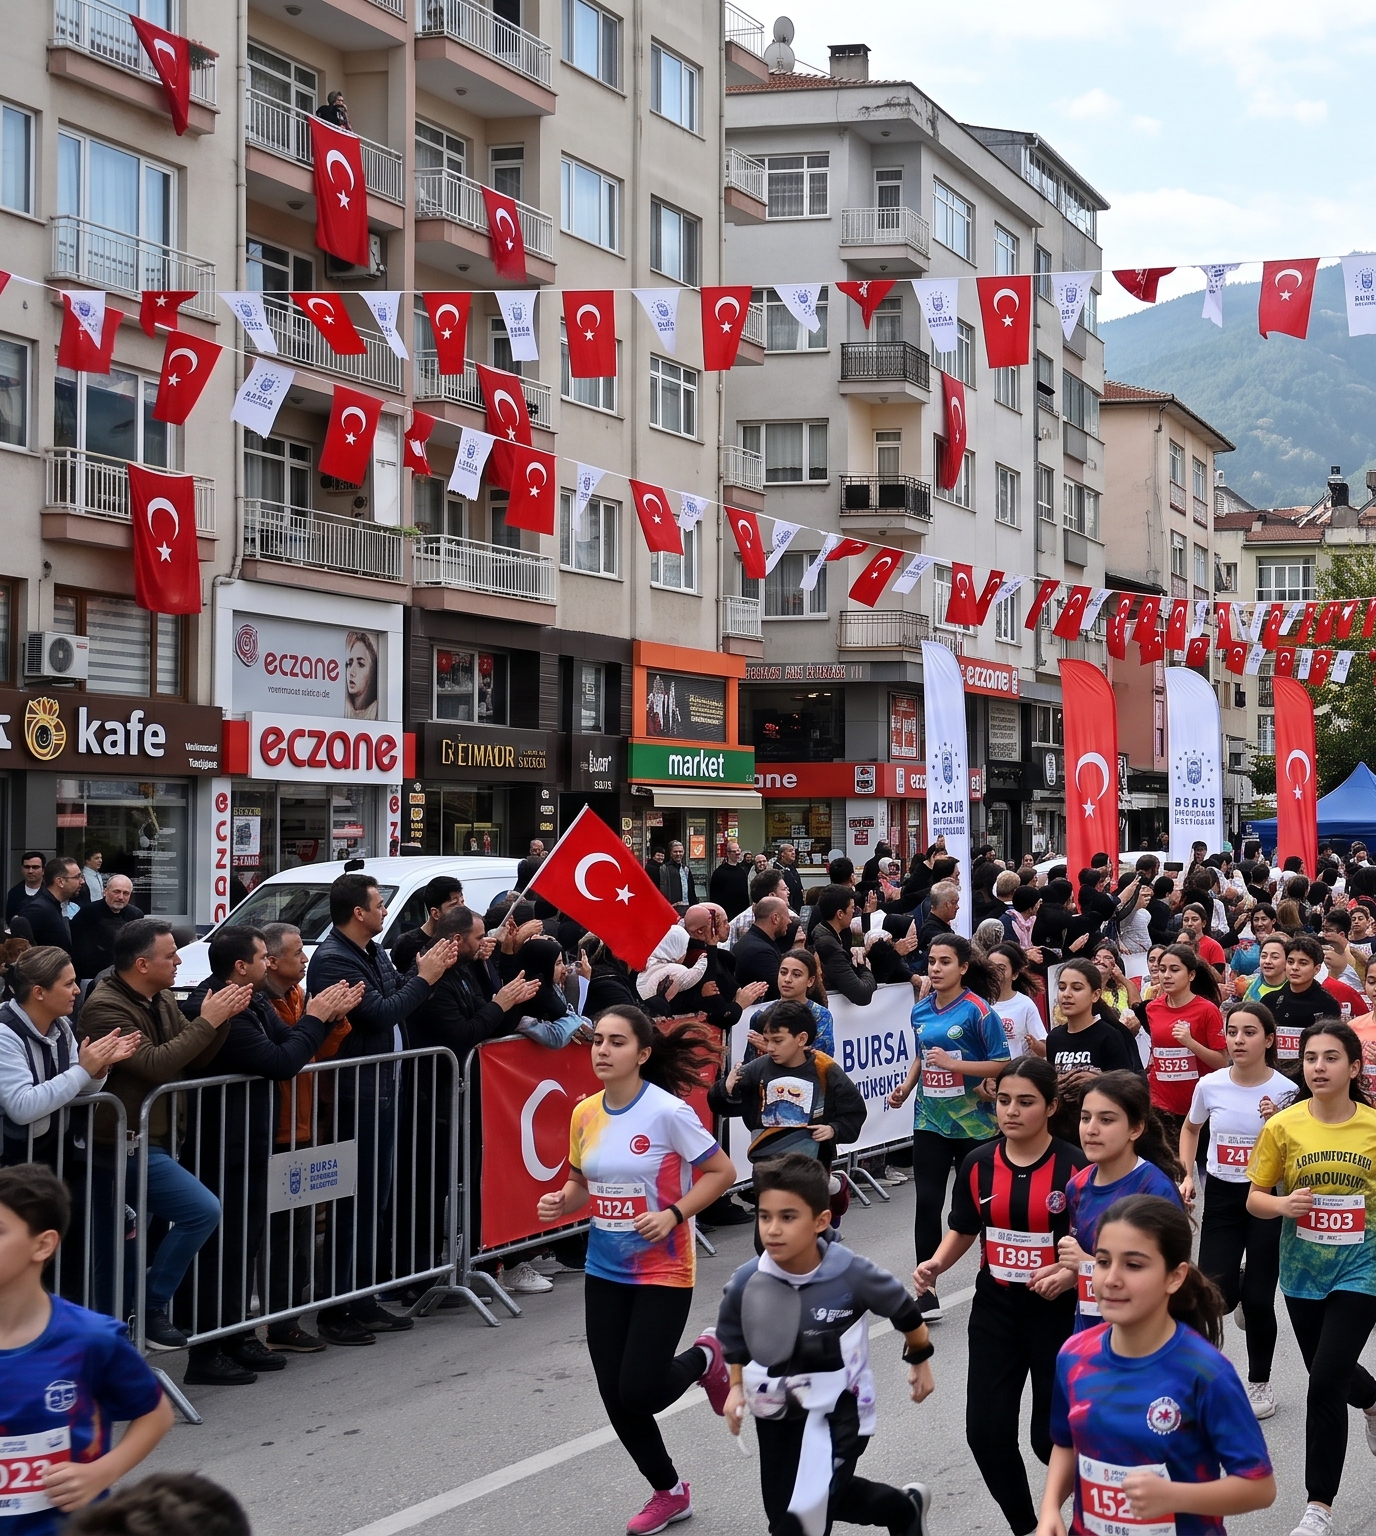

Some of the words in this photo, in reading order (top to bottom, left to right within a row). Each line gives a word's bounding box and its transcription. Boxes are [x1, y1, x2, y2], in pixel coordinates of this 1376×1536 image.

[264, 652, 340, 682] eczane
[78, 706, 166, 757] kafe
[260, 726, 398, 773] eczane
[668, 749, 725, 778] market
[842, 1029, 909, 1073] BURSA
[310, 1158, 338, 1174] BURSA
[1308, 1211, 1354, 1230] 1303
[996, 1246, 1043, 1268] 1395
[1090, 1487, 1143, 1520] 152
